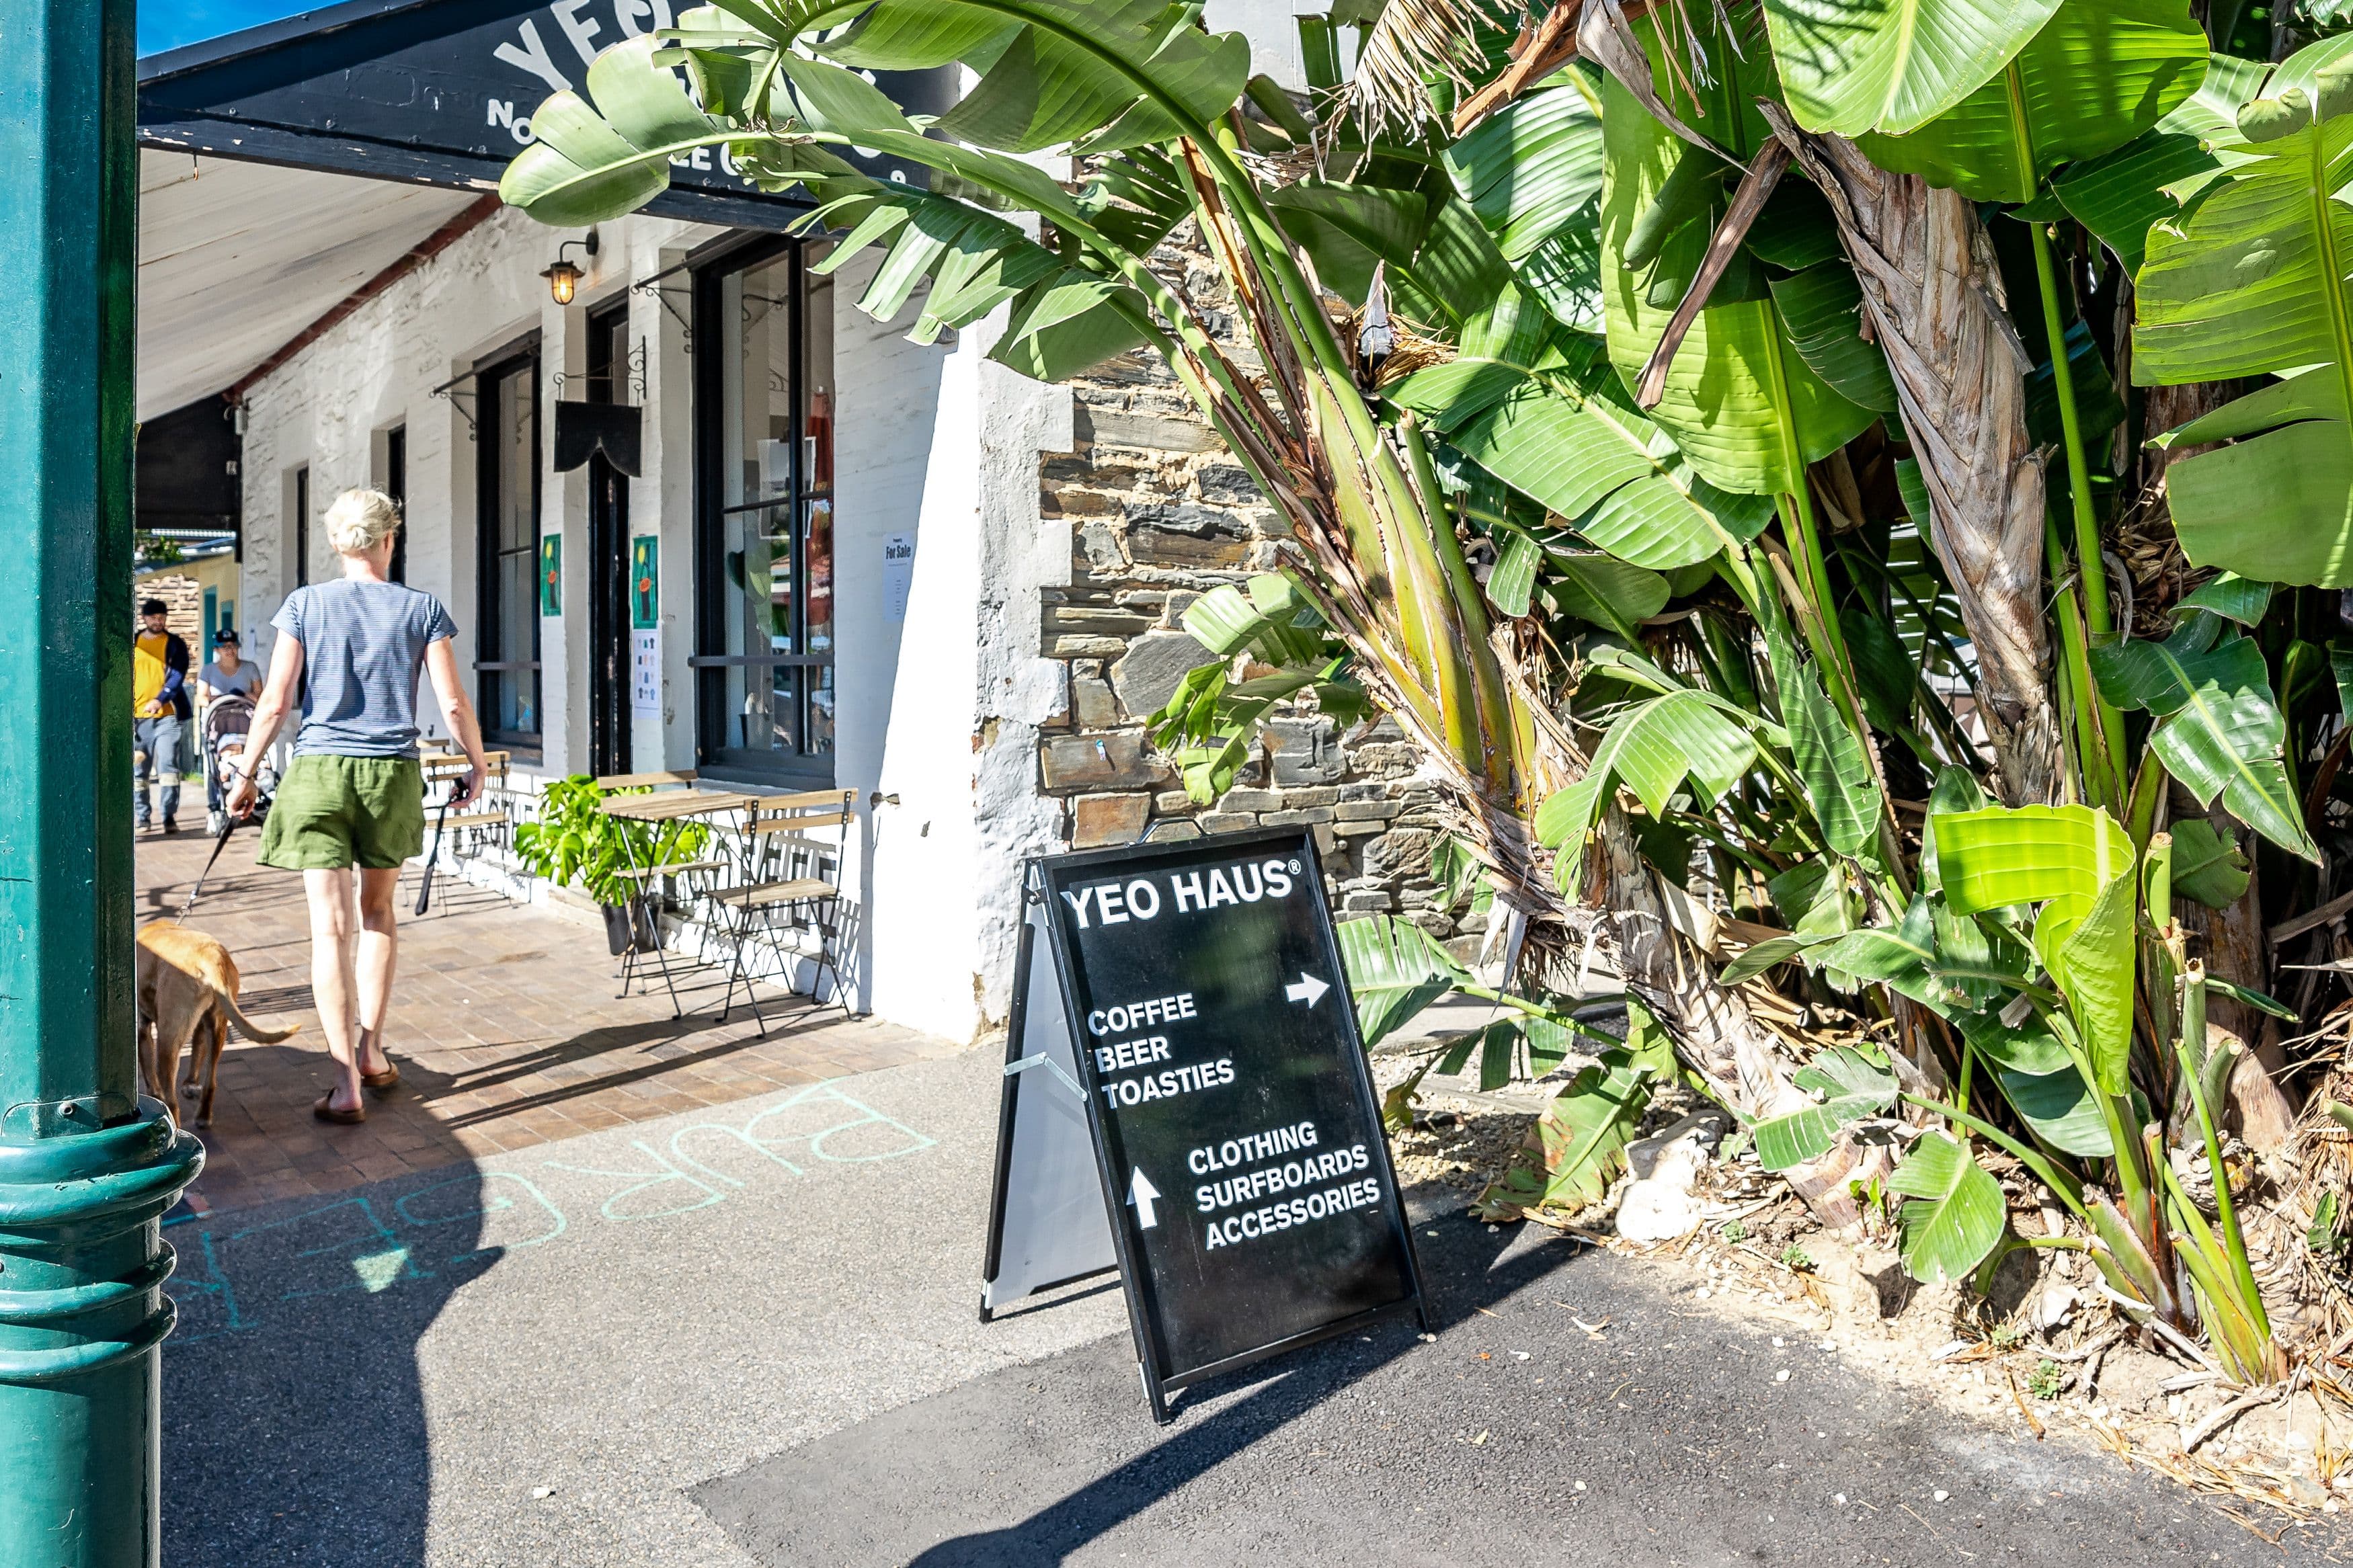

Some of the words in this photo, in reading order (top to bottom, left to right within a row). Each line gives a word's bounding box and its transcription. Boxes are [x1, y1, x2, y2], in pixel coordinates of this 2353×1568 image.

[885, 546, 896, 560] For
[897, 544, 912, 559] Sale
[1060, 879, 1161, 930] YEO
[1088, 993, 1197, 1036] COFFEE
[1094, 1036, 1172, 1073] BEER
[1101, 1058, 1235, 1109] TOASTIES
[1189, 1121, 1318, 1175] CLOTHING
[1196, 1145, 1370, 1212] SURFBOARDS
[1206, 1178, 1381, 1251] ACCESSORIES
